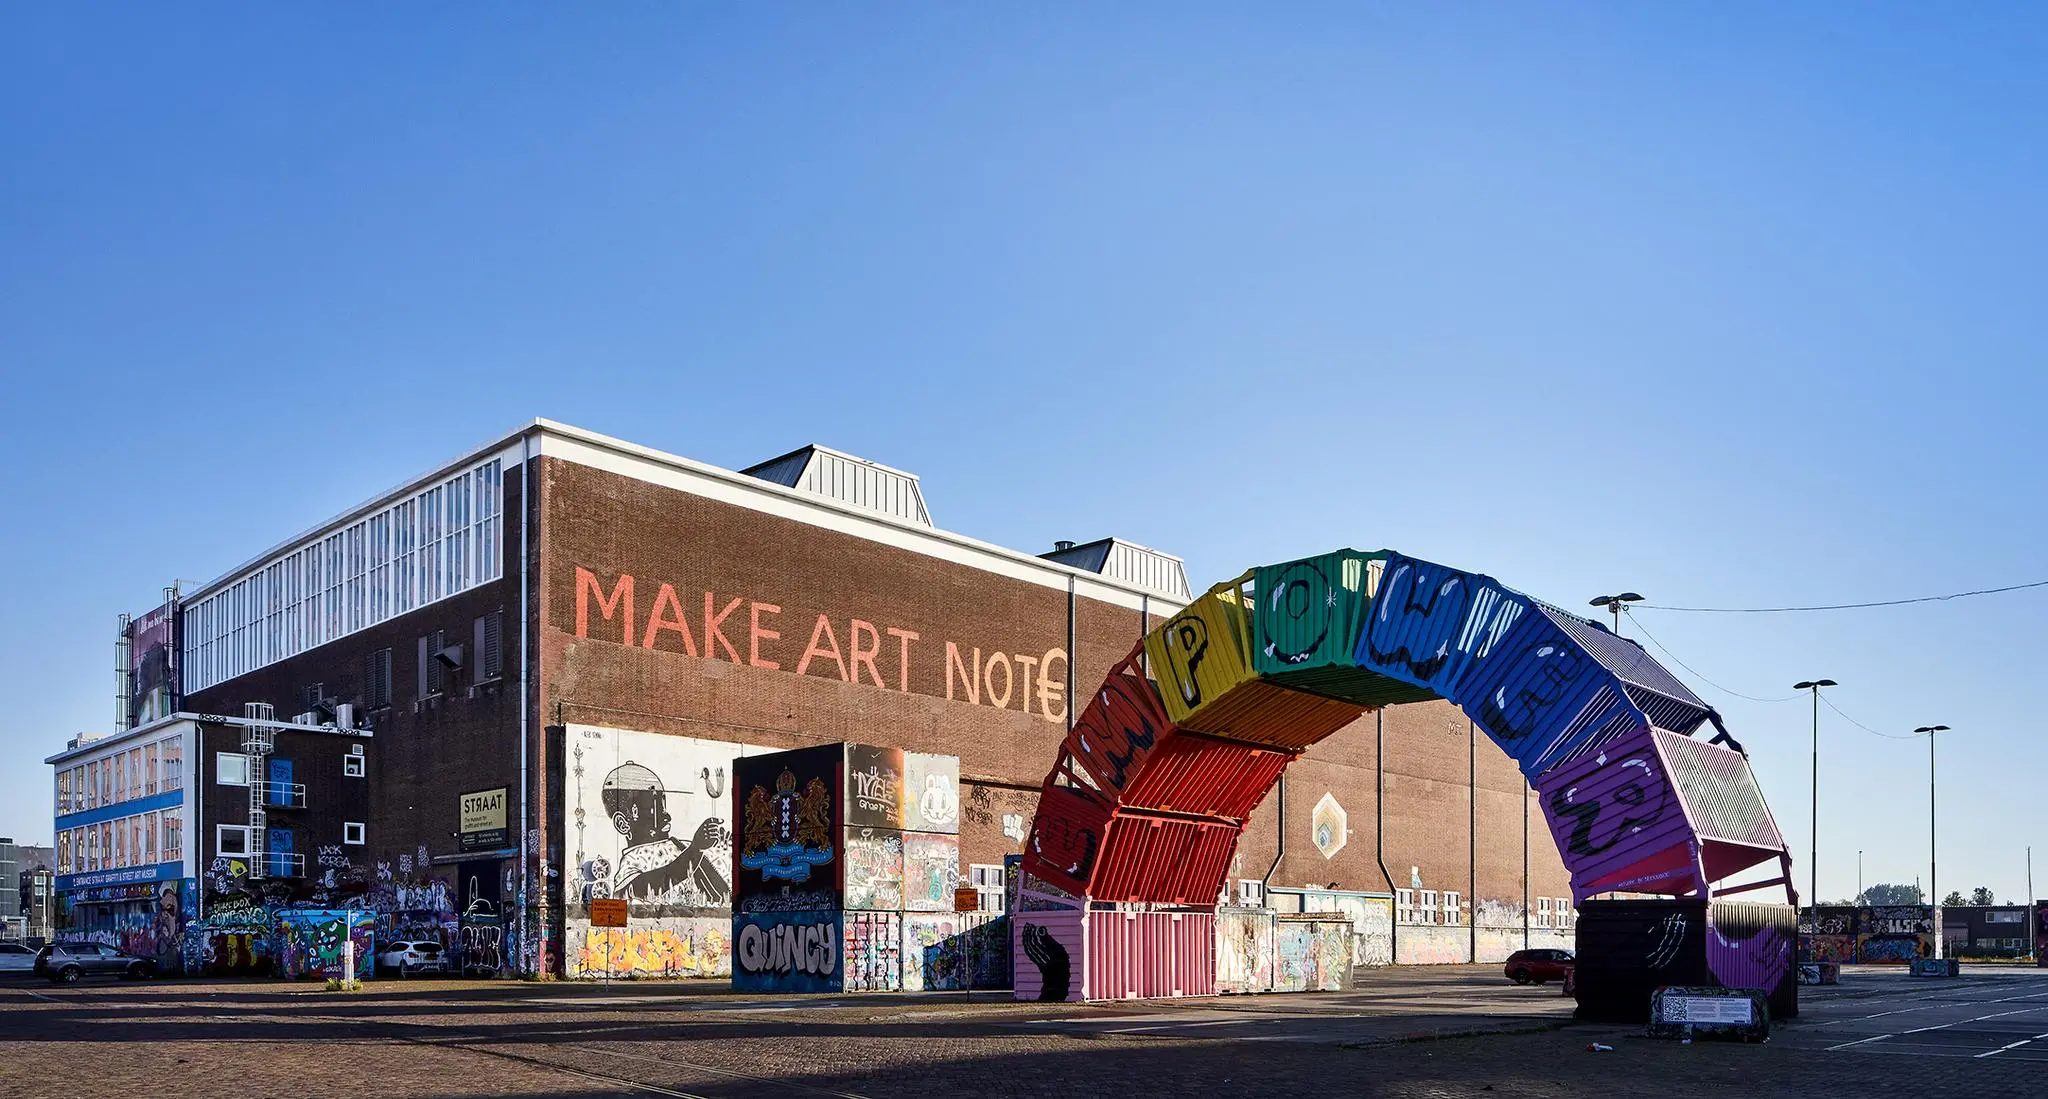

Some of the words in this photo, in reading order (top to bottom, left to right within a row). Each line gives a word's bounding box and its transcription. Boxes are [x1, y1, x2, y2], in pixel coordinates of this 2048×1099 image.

[575, 566, 782, 671] MAKE
[796, 613, 920, 696] ART
[464, 794, 503, 814] STRAAT
[739, 922, 837, 977] QUINCY
